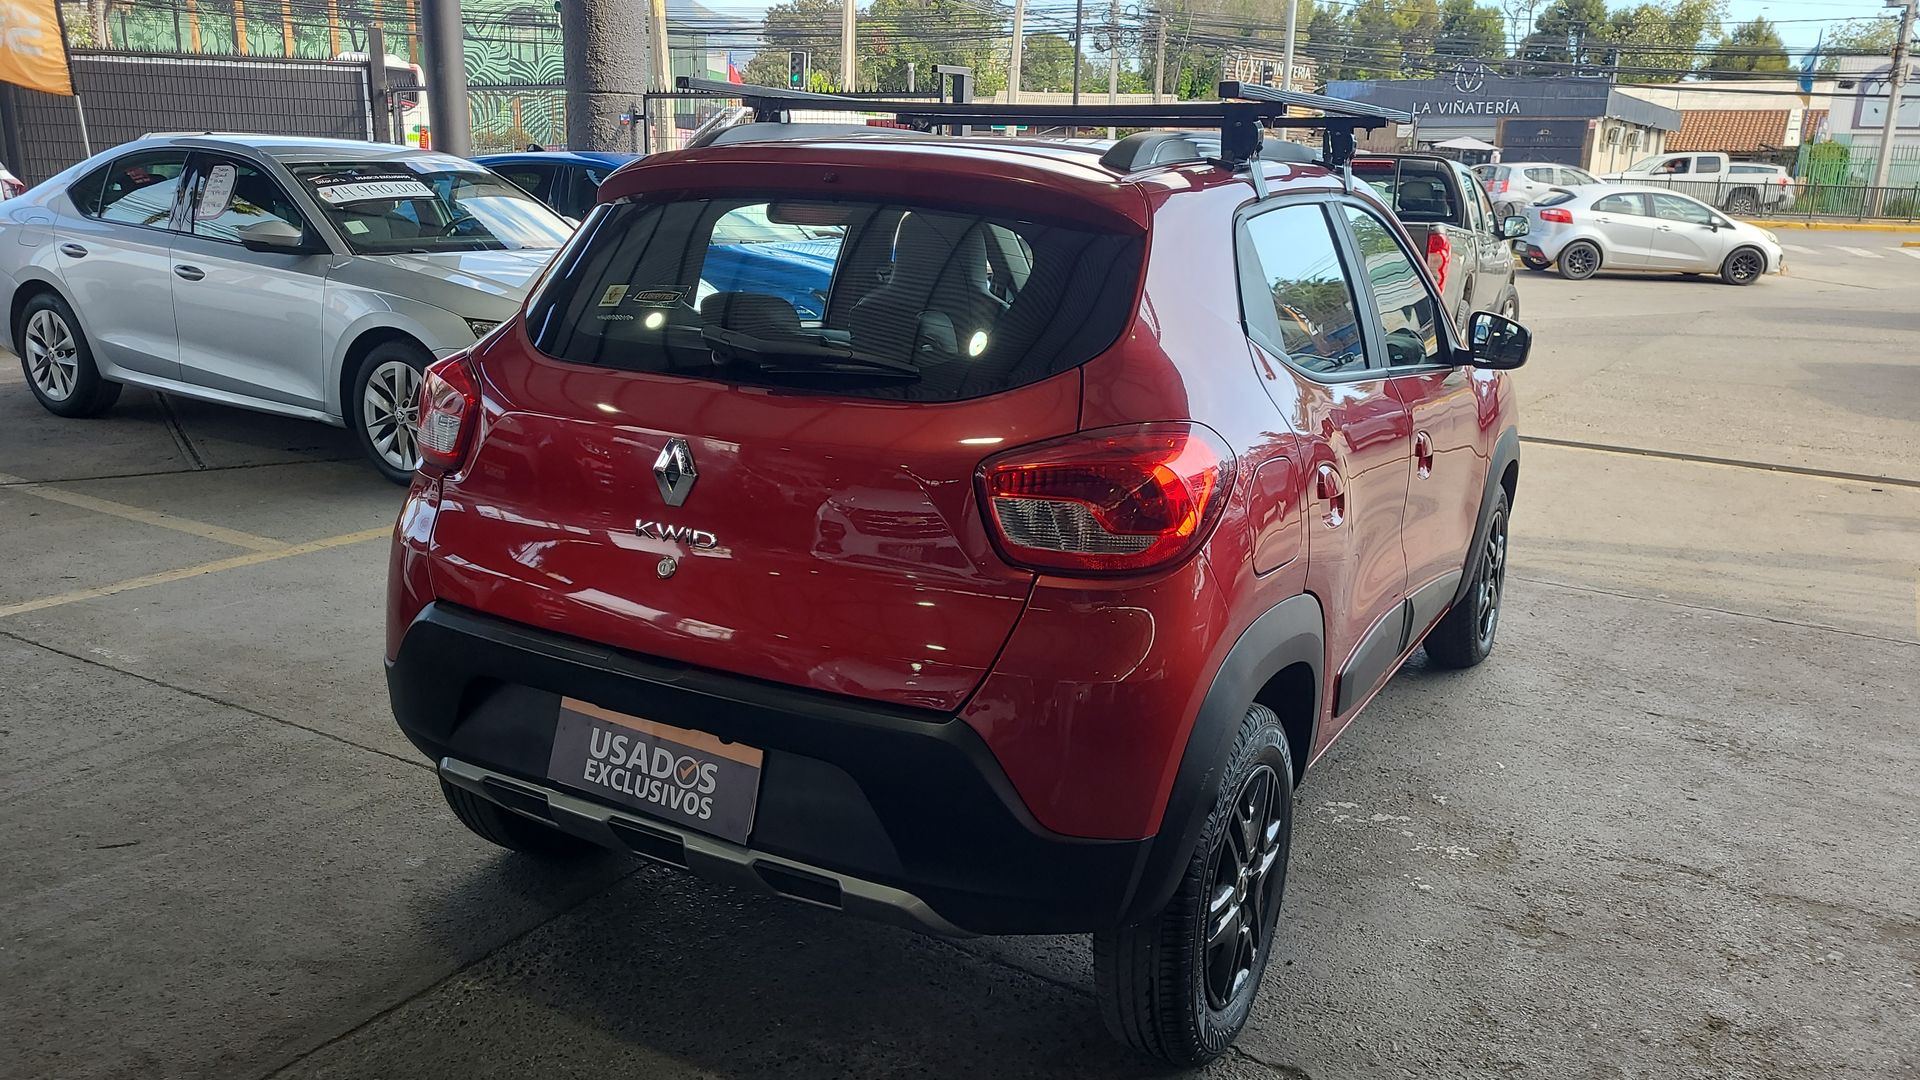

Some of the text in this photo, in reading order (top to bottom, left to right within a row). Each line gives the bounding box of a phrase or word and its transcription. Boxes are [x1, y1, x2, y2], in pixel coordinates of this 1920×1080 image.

[1412, 100, 1521, 114] LA VIÑATERÍA
[635, 519, 718, 549] KWID
[589, 727, 718, 794] USADOS
[583, 758, 713, 820] EXCLUSIVOS
